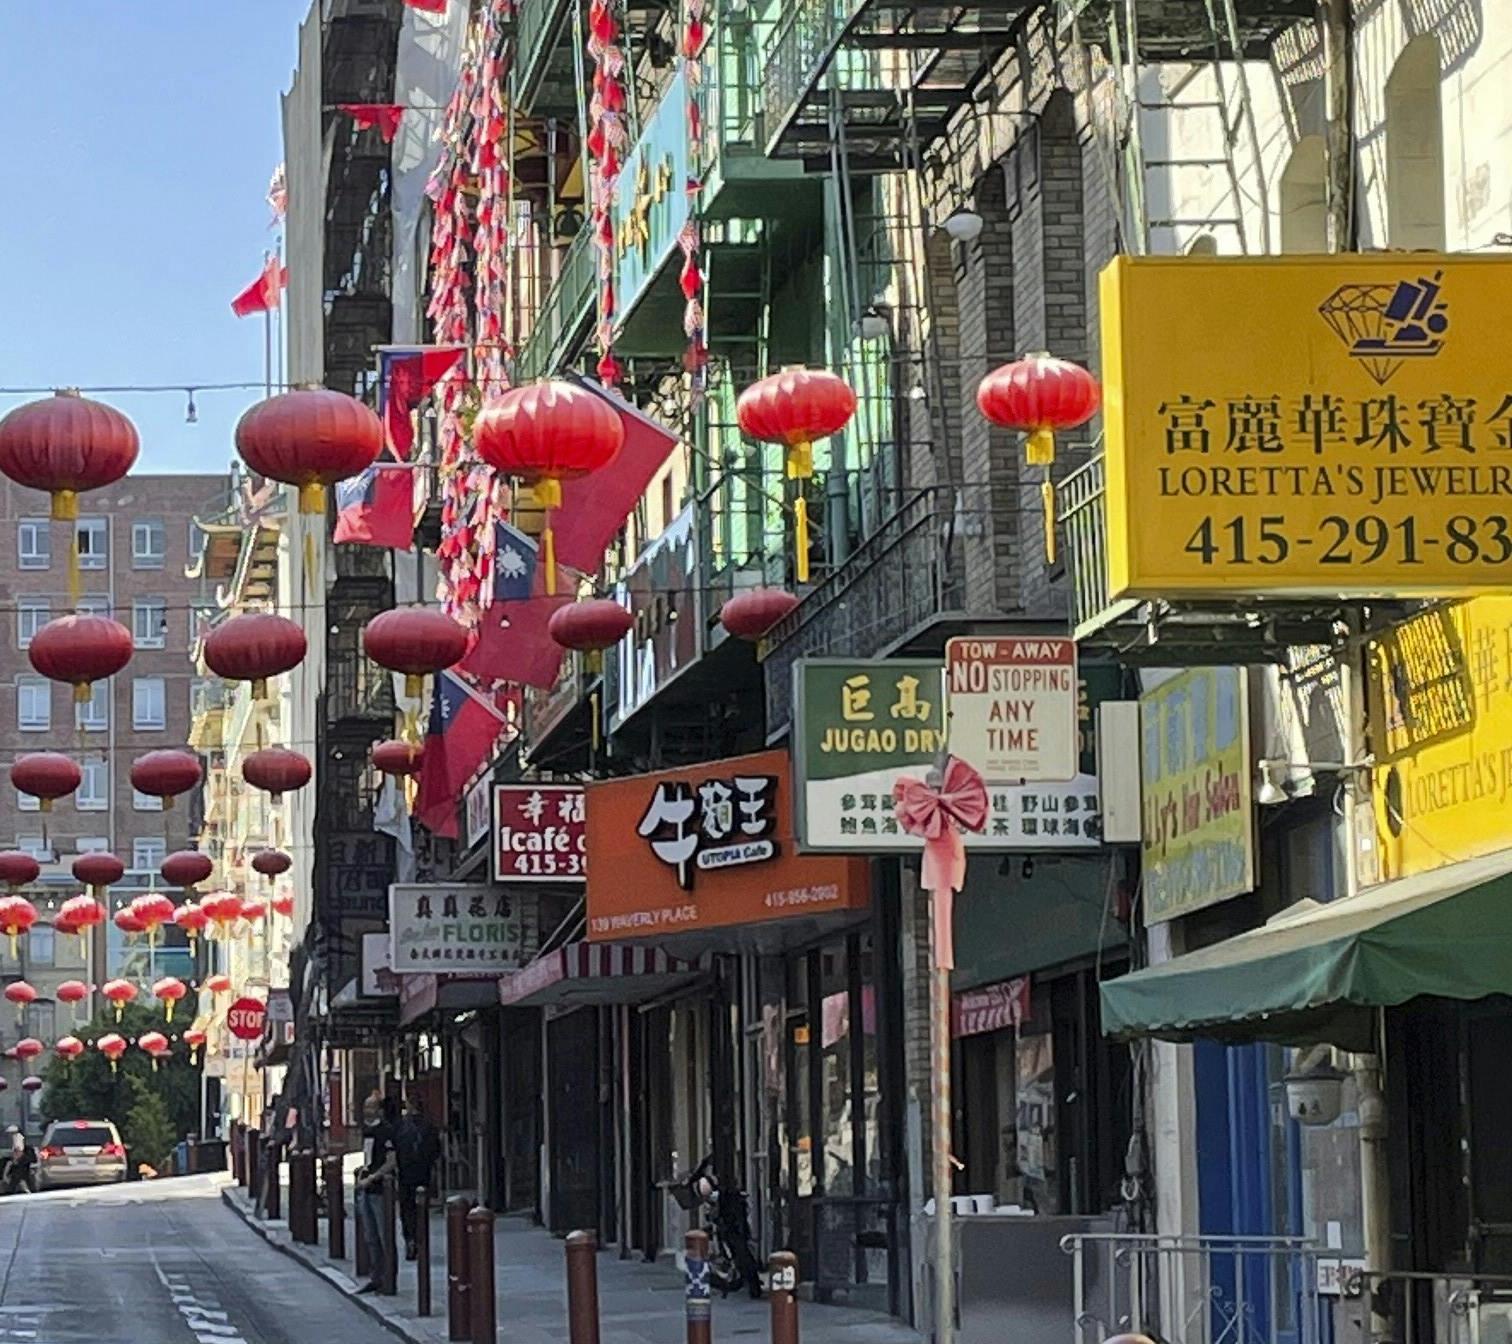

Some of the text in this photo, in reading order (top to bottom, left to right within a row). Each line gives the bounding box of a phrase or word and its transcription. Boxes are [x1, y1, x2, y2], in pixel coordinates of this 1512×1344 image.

[1159, 466, 1512, 505] LORETTA'S JEWELR
[1185, 515, 1512, 565] 415-291-83
[960, 642, 998, 658] TOW
[1012, 642, 1063, 658] AWAY
[952, 661, 1070, 693] NO STOPPING
[989, 701, 1034, 722] ANY
[821, 729, 897, 753] JUGAO
[986, 729, 1039, 751] TIME
[702, 850, 741, 866] UTOPIA
[660, 905, 698, 922] PLACE
[228, 1010, 265, 1028] STOP
